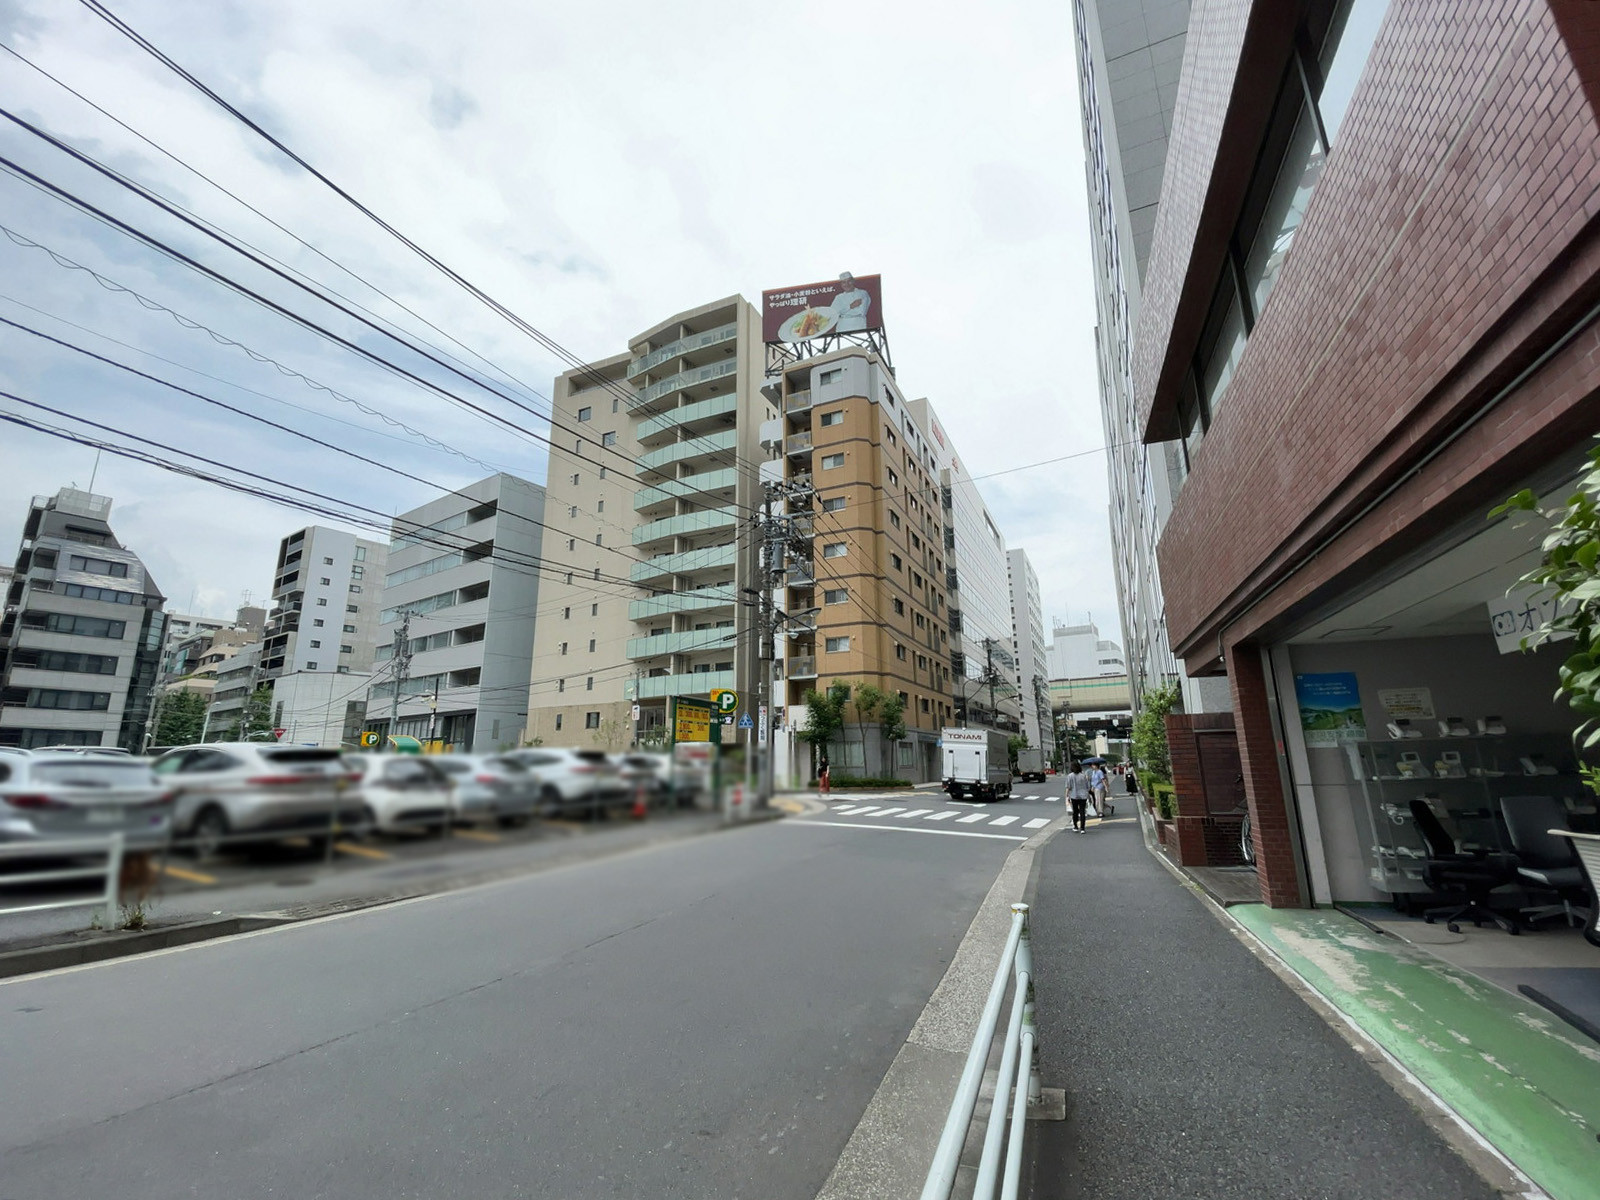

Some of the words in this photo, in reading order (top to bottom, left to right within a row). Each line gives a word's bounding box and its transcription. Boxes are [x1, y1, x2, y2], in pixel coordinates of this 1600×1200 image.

[769, 297, 807, 307] やっぱり理研
[722, 694, 734, 709] P
[369, 735, 377, 744] P
